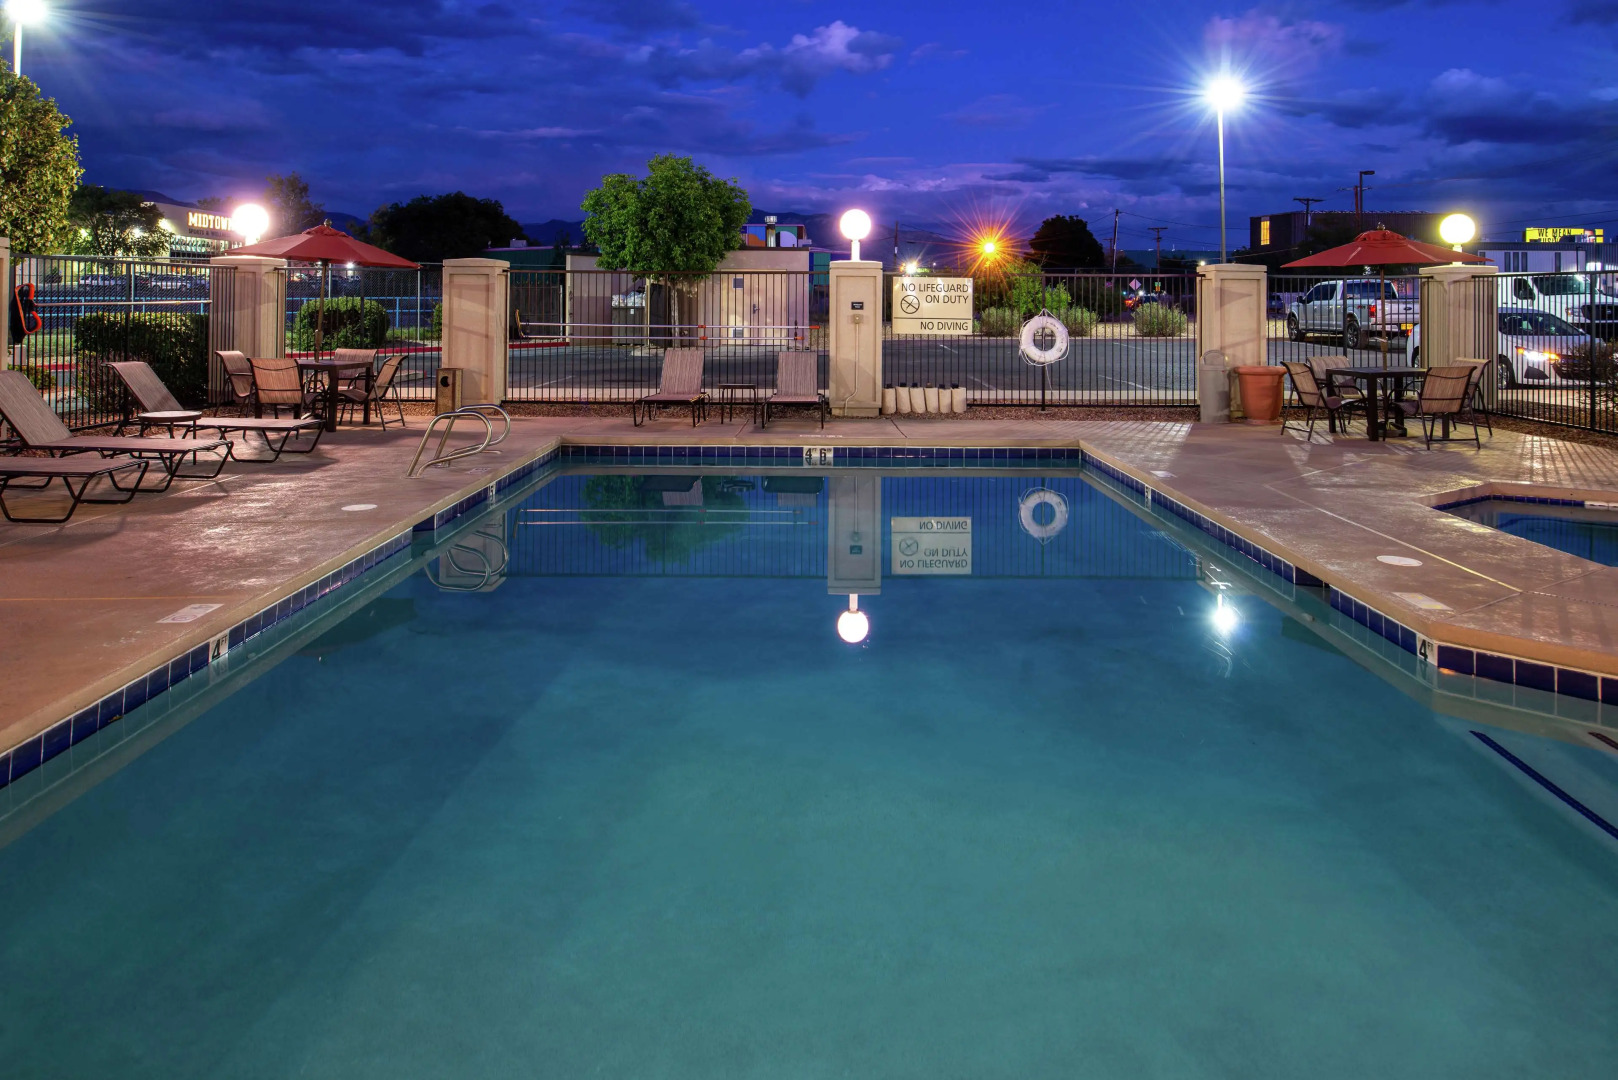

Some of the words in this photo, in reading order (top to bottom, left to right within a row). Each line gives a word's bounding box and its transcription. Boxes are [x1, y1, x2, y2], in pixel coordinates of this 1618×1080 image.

[1537, 228, 1548, 237] WE
[1552, 228, 1571, 237] MEAN
[901, 283, 916, 292] NO
[918, 283, 969, 293] LIFEGUARD
[925, 295, 940, 304] ON
[942, 295, 969, 304] DUTY
[920, 321, 935, 330] NO
[937, 322, 969, 331] DIVING
[805, 448, 812, 457] 4
[820, 448, 827, 457] 6
[212, 638, 221, 659] 4
[1419, 639, 1428, 662] 4
